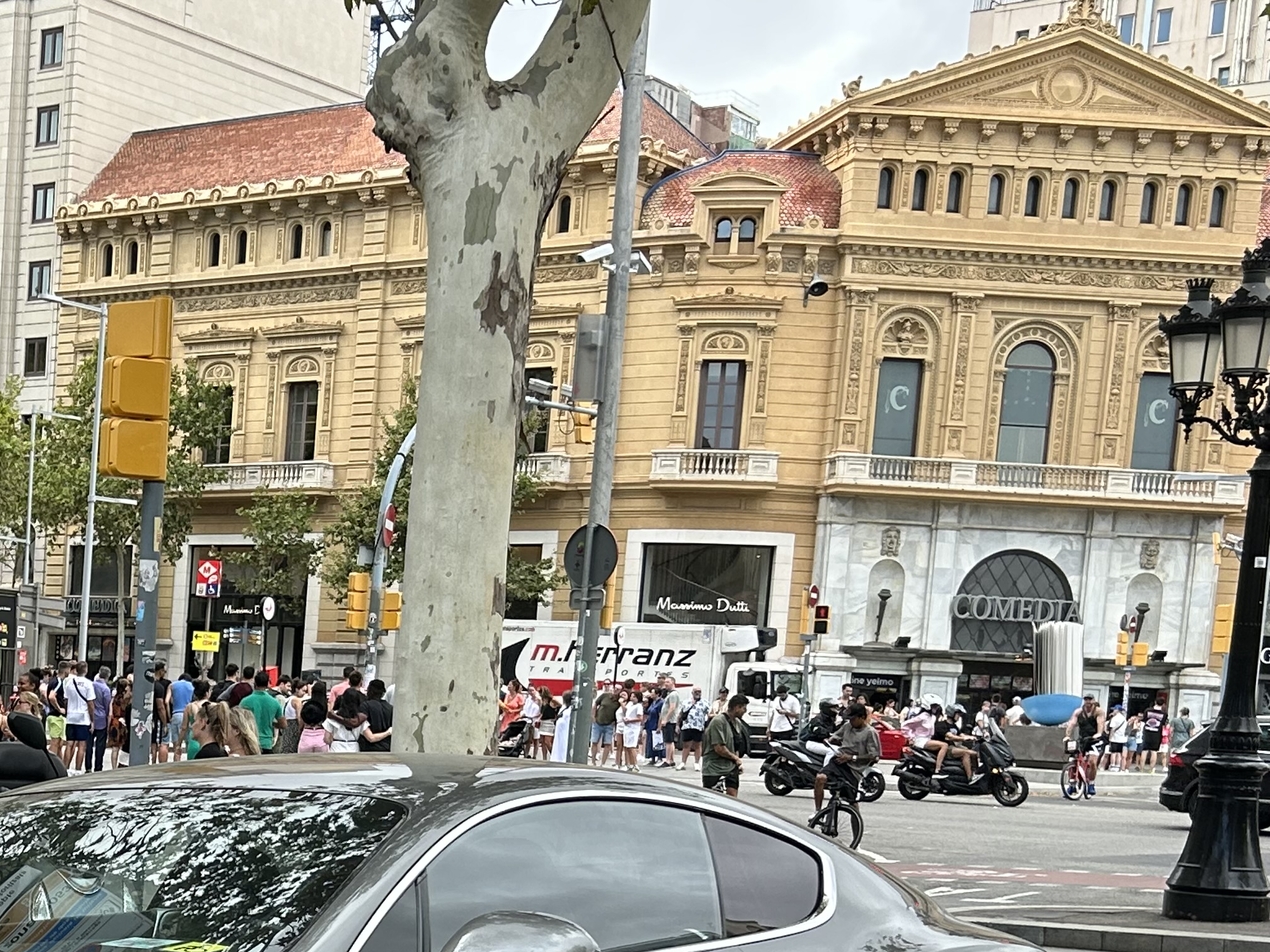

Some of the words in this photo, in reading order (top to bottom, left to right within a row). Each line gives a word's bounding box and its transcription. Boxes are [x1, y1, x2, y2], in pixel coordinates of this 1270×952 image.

[656, 596, 713, 611] Massimo
[716, 598, 750, 613] Dutti
[953, 594, 1083, 625] COMEDIA
[530, 665, 690, 680] TRAPORTES
